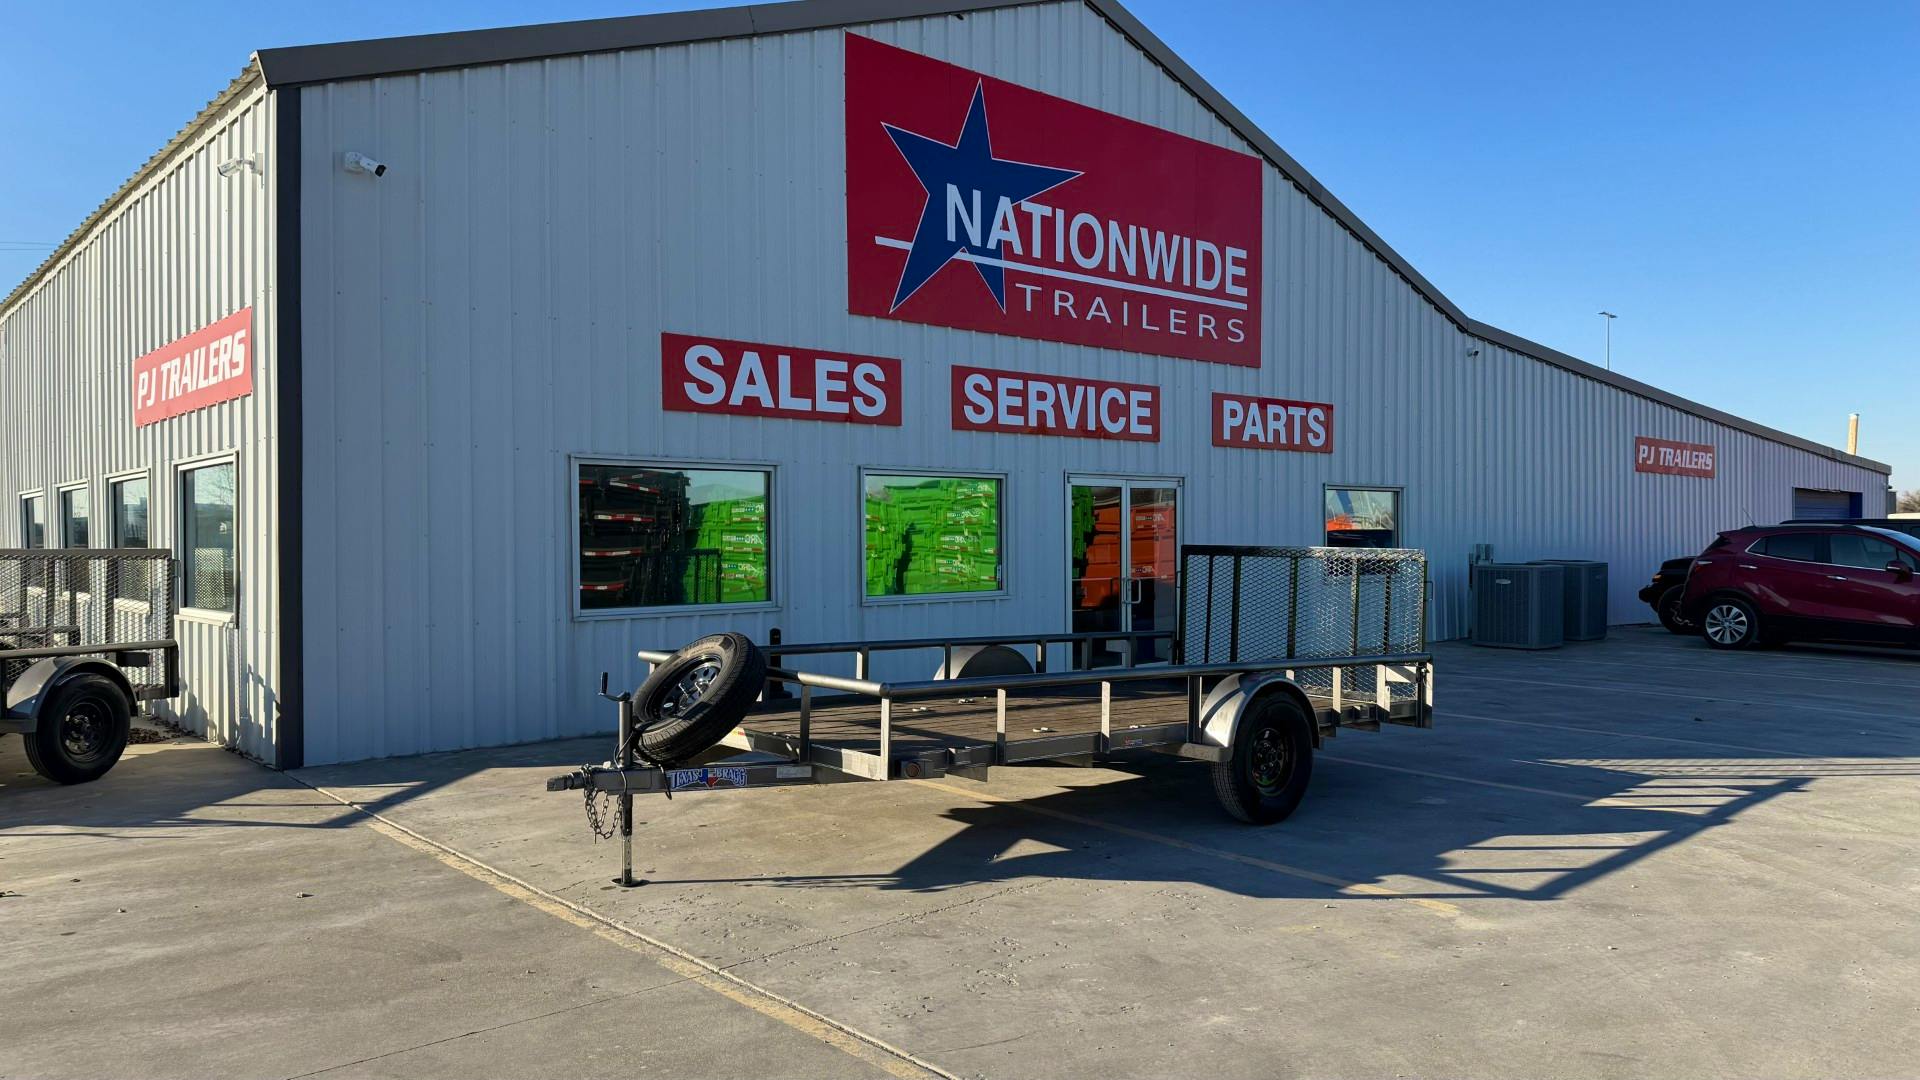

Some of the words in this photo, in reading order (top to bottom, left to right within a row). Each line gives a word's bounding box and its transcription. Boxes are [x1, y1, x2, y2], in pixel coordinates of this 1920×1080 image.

[946, 183, 1248, 297] NATIONWIDE
[1015, 283, 1246, 343] TRAILERS
[137, 367, 157, 410] PJ
[160, 329, 246, 402] TRAILERS
[683, 344, 887, 417] SALES
[963, 373, 1153, 435] SERVICE
[1222, 400, 1326, 447] PARTS
[1638, 444, 1655, 465] PJ
[1658, 447, 1713, 470] TRAILERS
[667, 769, 702, 789] TEXAS
[715, 767, 748, 787] BRAGG
